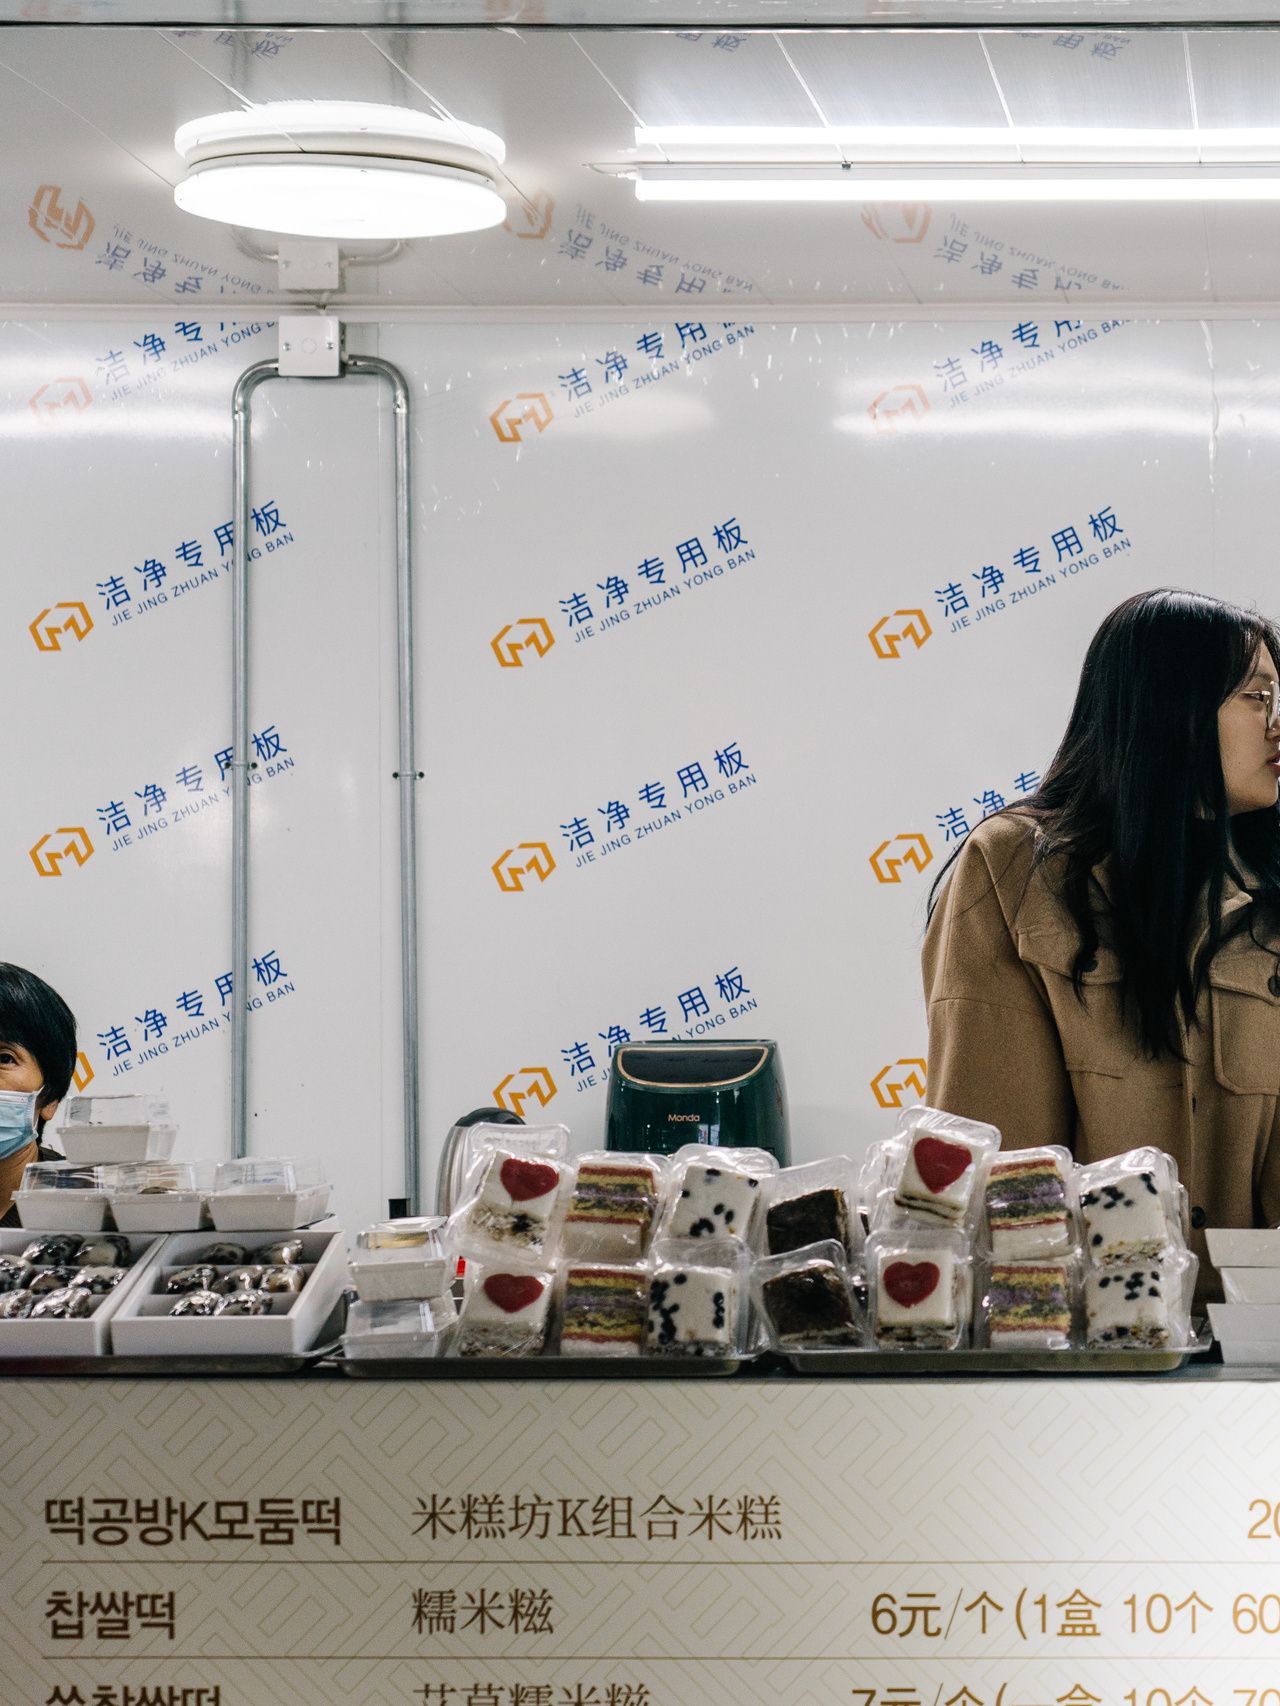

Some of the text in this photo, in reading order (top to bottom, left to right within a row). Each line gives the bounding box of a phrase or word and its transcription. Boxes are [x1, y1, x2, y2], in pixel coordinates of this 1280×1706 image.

[96, 322, 236, 385] 洁净专
[171, 343, 217, 373] ZHUAN
[221, 323, 260, 347] YONG
[558, 323, 737, 402] 洁净专用
[574, 324, 754, 418] JIE JING ZHUAN YONG BAN
[933, 320, 1082, 392] 洁净专
[949, 320, 1129, 407] JIE JING ZHUAN YONG BA
[96, 500, 286, 610] 洁净专用板
[113, 532, 293, 626] JIE JING ZHUAN YNG BAN
[558, 517, 748, 627] 洁净专用板
[575, 549, 755, 643] JIE JING ZHUAN YONG BAN
[934, 506, 1124, 616] 洁净专用板
[951, 538, 1131, 632] JIE JING ZHUAN YONG BAN
[96, 725, 286, 835] 洁净专用板
[113, 757, 293, 851] JIE JING ZHUAN YNG BAN
[559, 742, 749, 852] 洁净专用板
[576, 774, 756, 868] JIE JING ZHUAN YONG BAN
[935, 771, 1040, 842] 洁净专
[97, 950, 287, 1060] 洁净专用板
[114, 982, 294, 1076] JIE JING ZHUAN YNG BAN
[560, 966, 750, 1076] 洁净专用板
[577, 1074, 596, 1092] JIE
[686, 1014, 725, 1038] YONG
[729, 998, 757, 1019] BAN
[668, 1113, 700, 1122] Monda
[44, 1496, 342, 1546] 떡공방K모둠떡
[410, 1494, 782, 1541] 米糕坊K组合米糕
[44, 1590, 176, 1640] 찹쌀떡
[410, 1587, 555, 1636] 糯米糍
[1123, 1591, 1214, 1636] 10个
